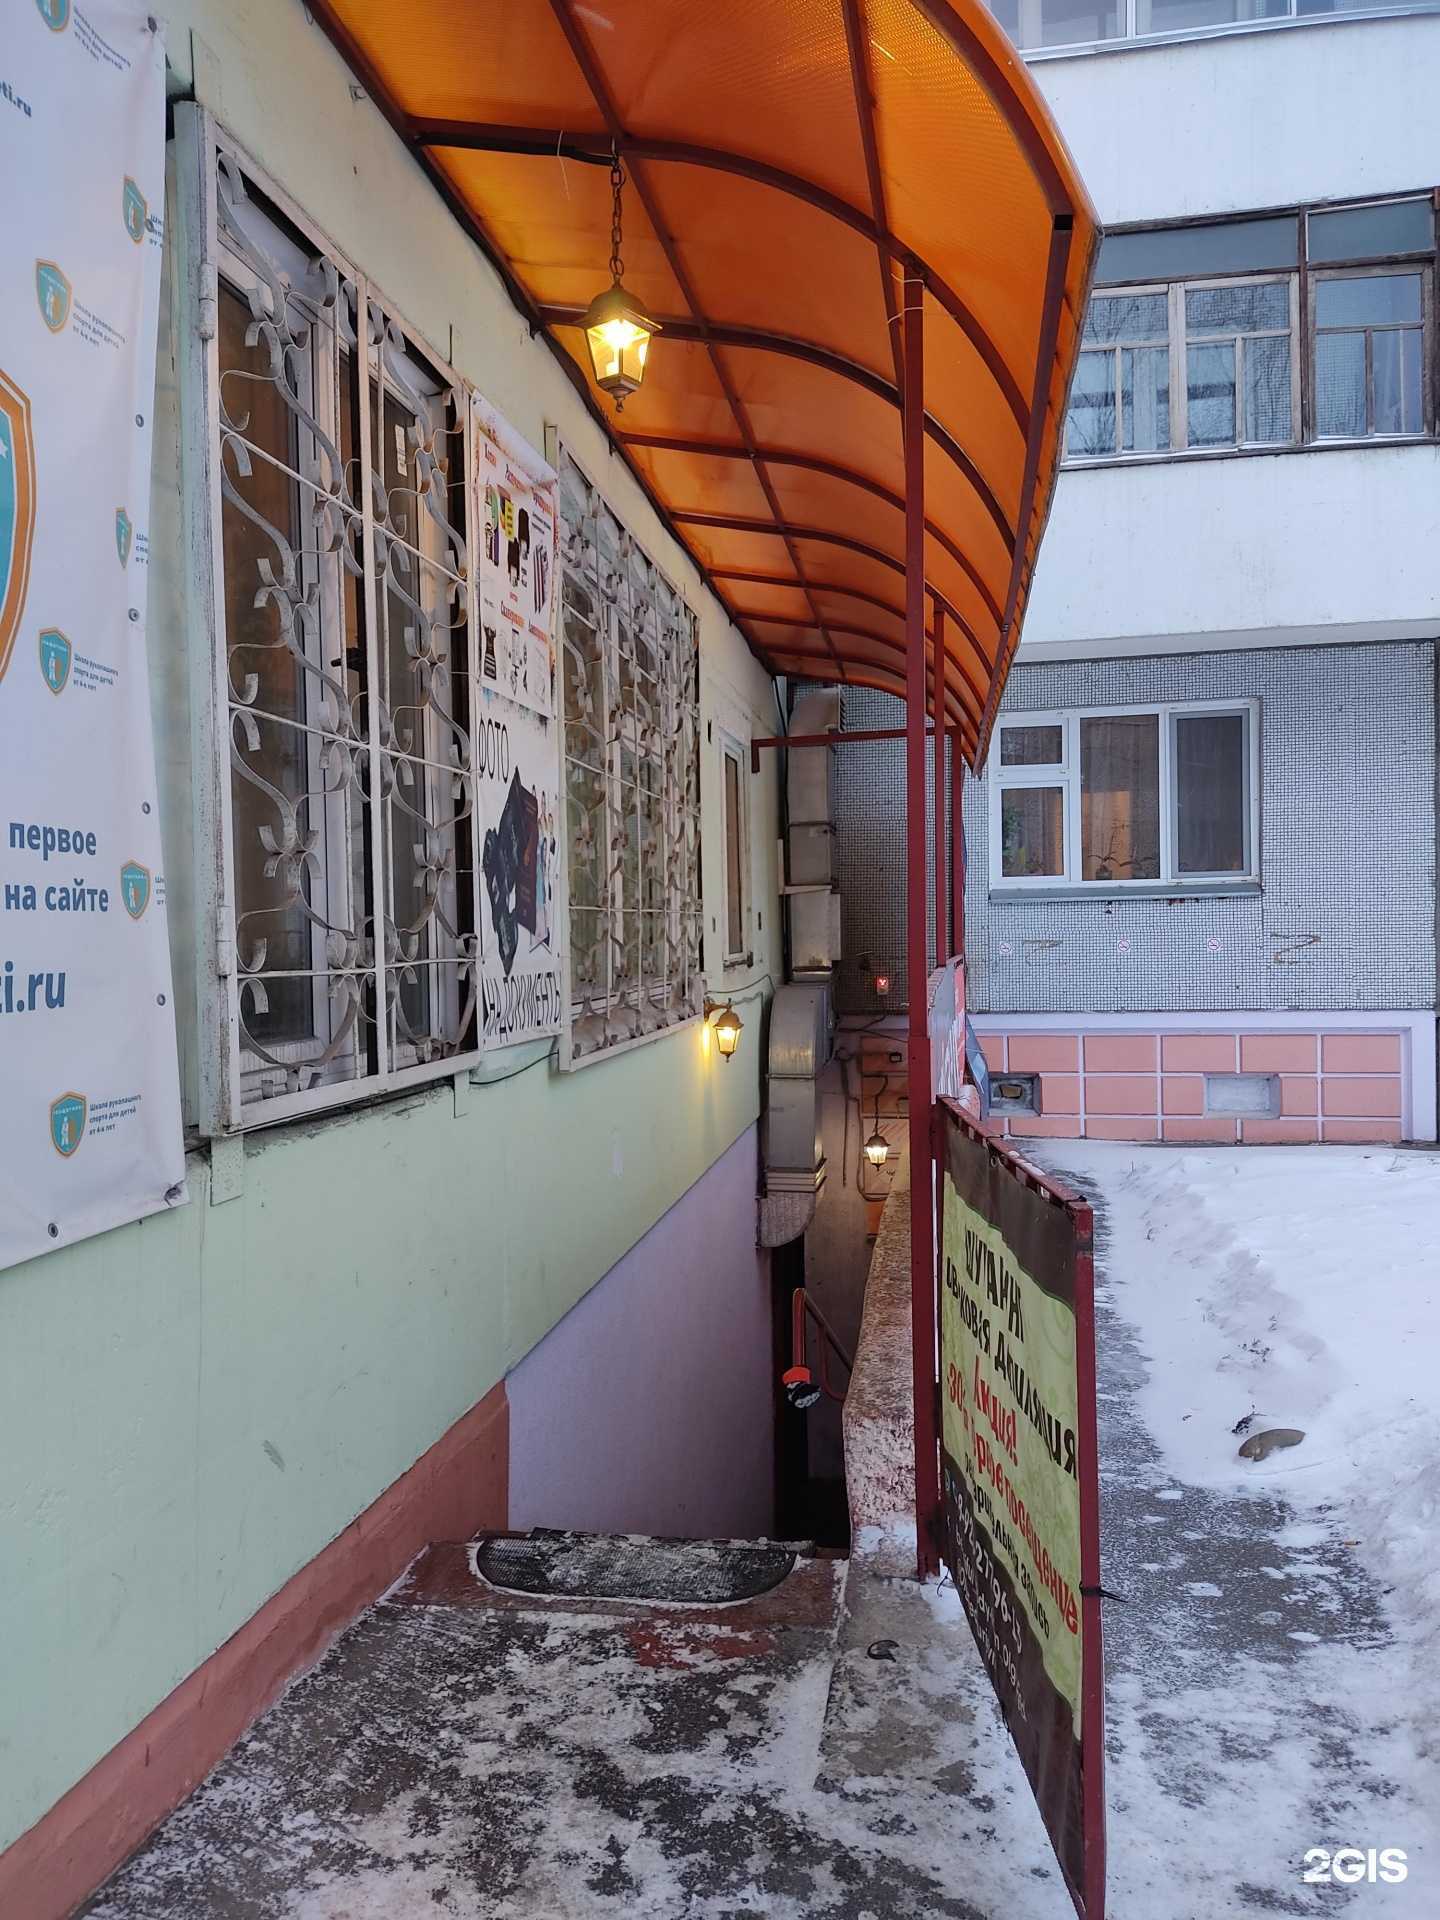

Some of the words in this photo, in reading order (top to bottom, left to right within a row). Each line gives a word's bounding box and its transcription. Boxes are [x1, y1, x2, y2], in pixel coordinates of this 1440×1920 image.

[478, 712, 510, 784] ФОТО
[9, 822, 97, 861] первое
[5, 884, 37, 911] на
[44, 878, 109, 913] сайте
[0, 960, 66, 1014] i.ru
